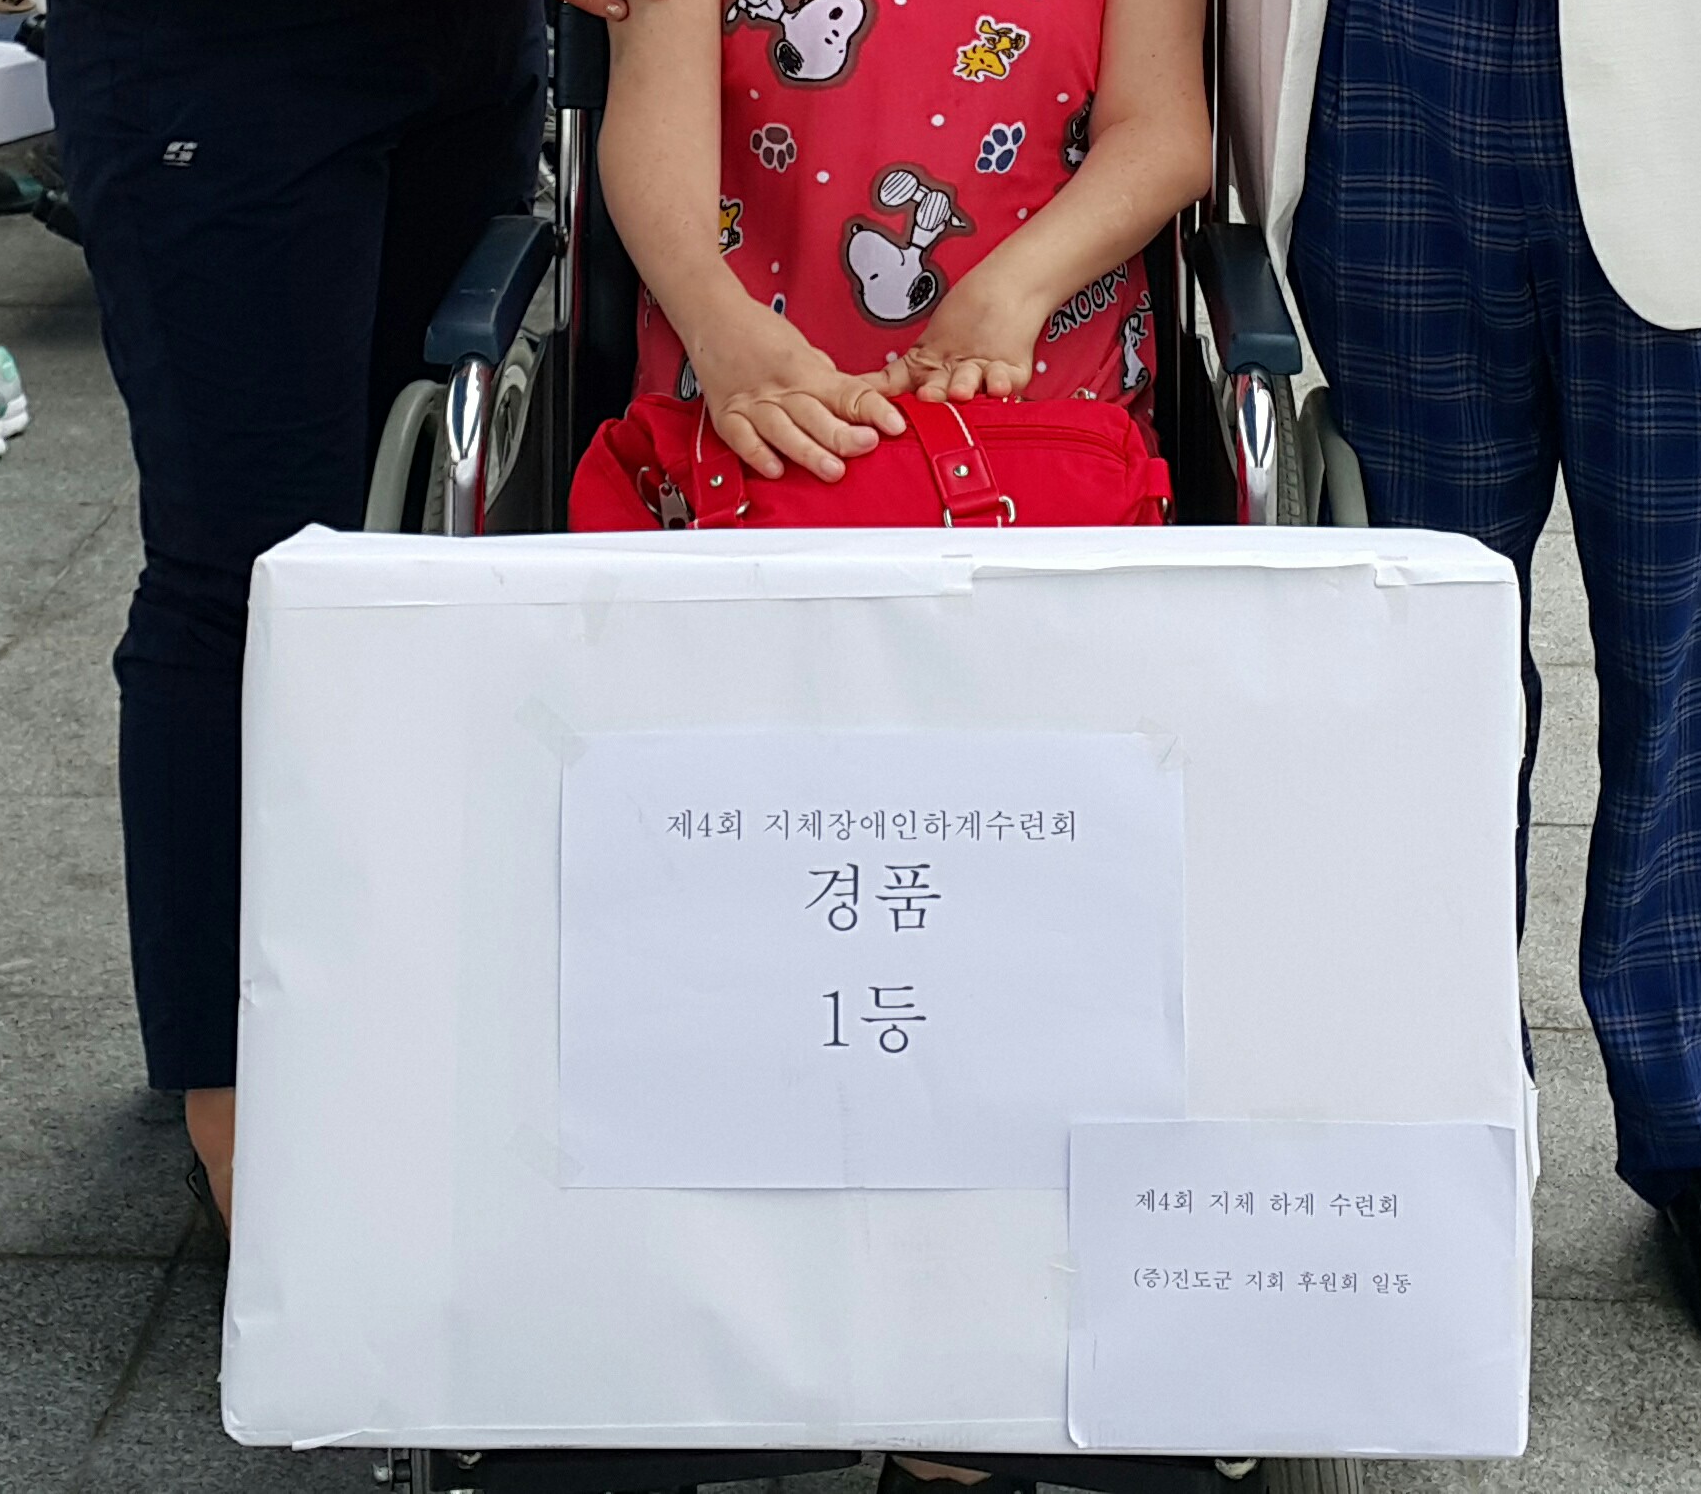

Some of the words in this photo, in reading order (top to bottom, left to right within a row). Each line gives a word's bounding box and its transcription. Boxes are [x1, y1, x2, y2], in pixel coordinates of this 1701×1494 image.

[1046, 263, 1128, 342] SNOOPY
[666, 809, 742, 841] 제4회
[763, 808, 1076, 842] 지체장애인하계수련회
[804, 862, 942, 933] 경품
[822, 985, 927, 1054] 1등
[1135, 1188, 1193, 1214] 제4회
[1209, 1190, 1254, 1215] 지체
[1269, 1191, 1314, 1217] 하계
[1329, 1192, 1398, 1218] 수련회
[1246, 1270, 1284, 1292] 지회
[1297, 1270, 1358, 1293] 후원회
[1372, 1272, 1412, 1294] 일동
